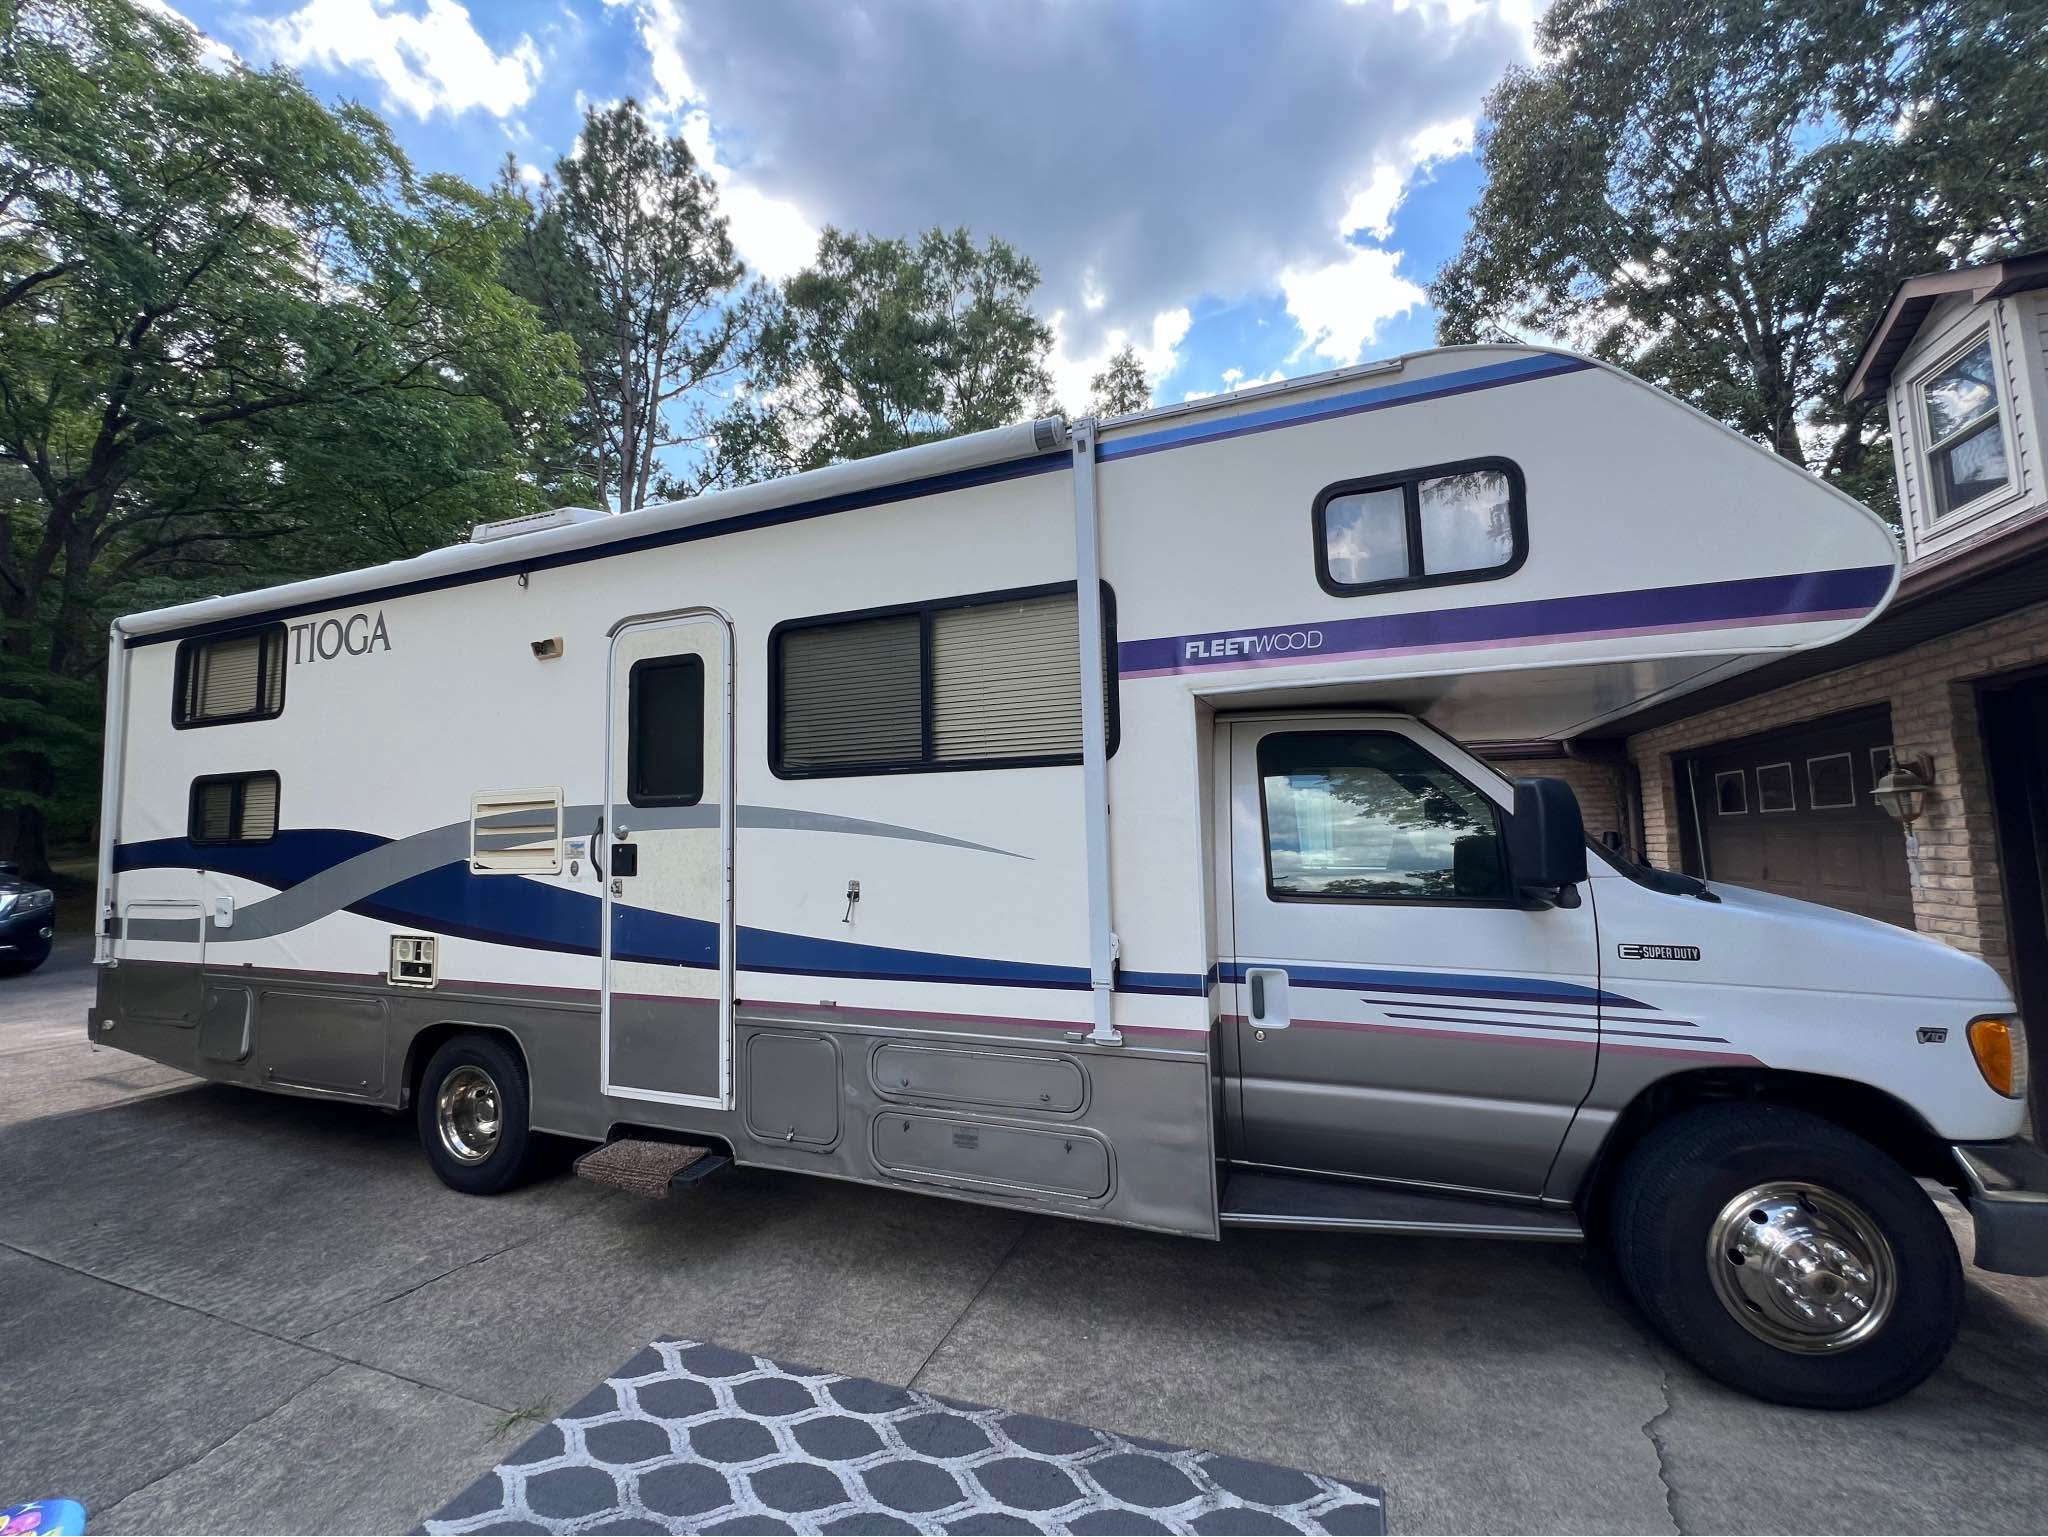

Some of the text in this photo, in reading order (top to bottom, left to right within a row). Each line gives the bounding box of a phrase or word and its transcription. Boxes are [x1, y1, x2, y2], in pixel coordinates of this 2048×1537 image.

[290, 609, 391, 664] TIOGA
[1185, 630, 1323, 659] FLEETWOOD
[1674, 948, 1698, 960] DUTY
